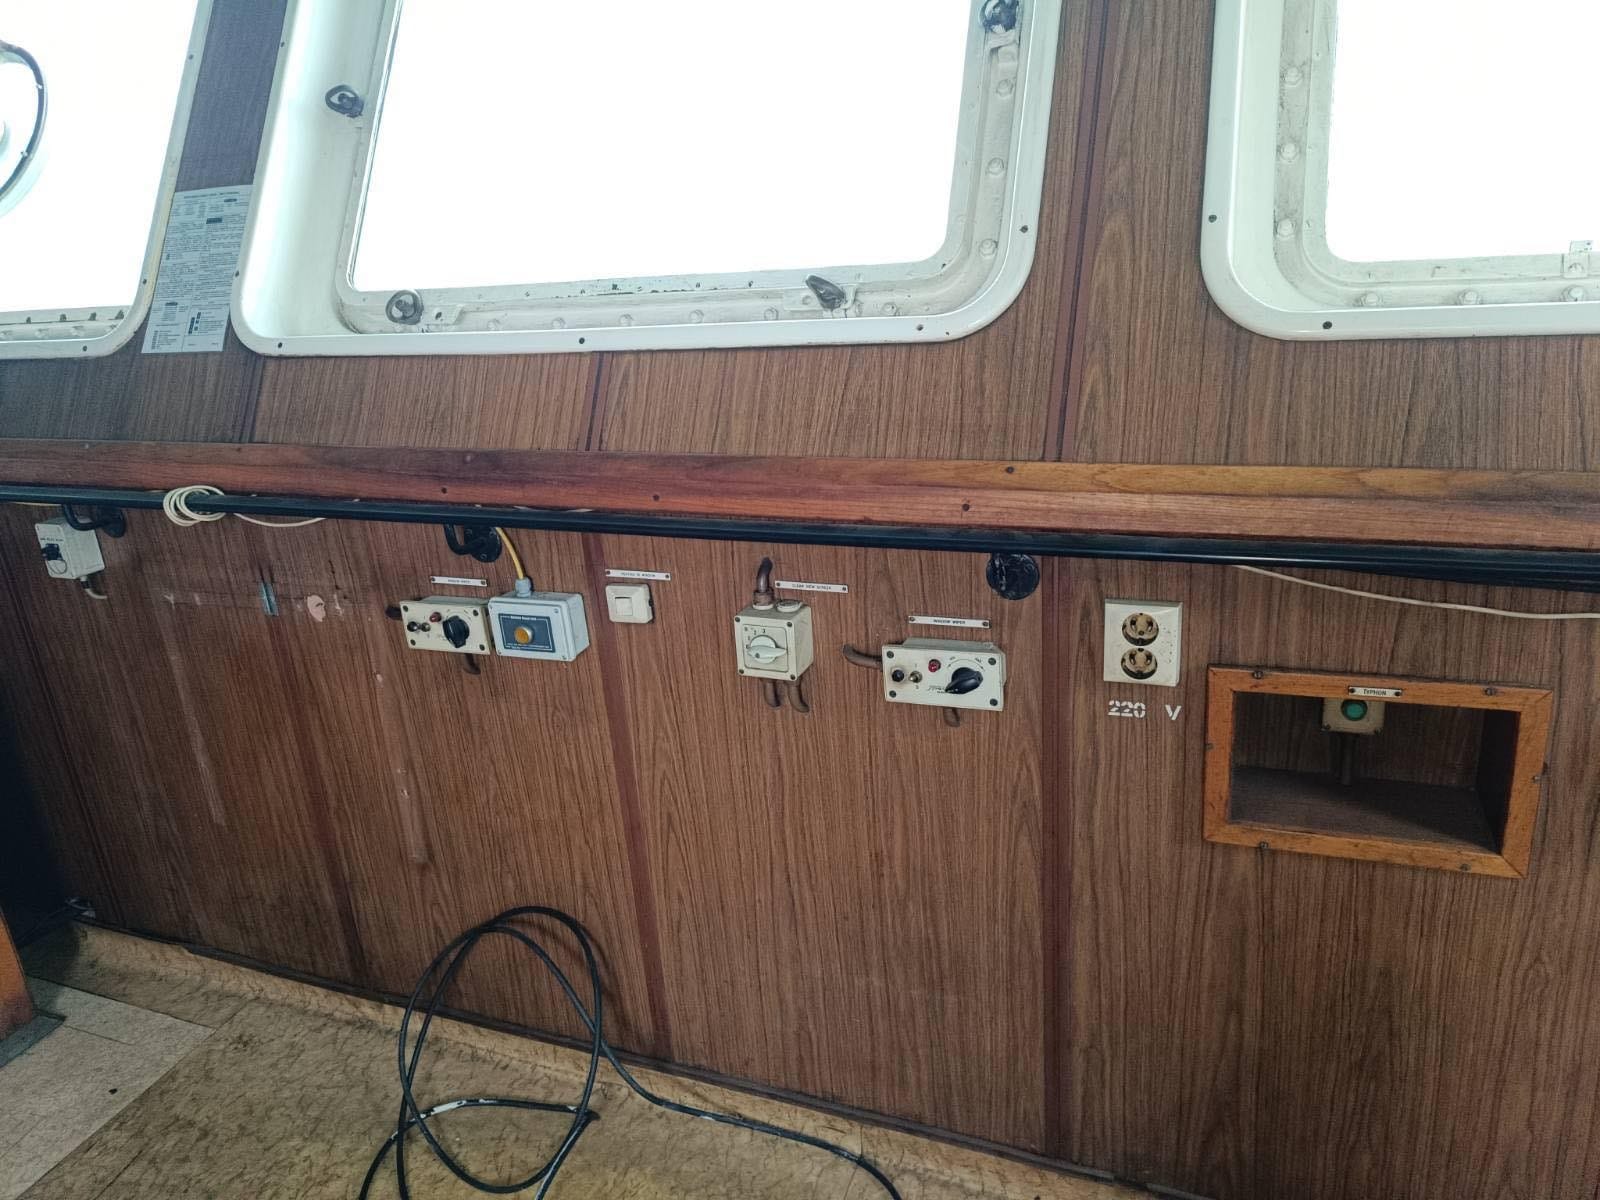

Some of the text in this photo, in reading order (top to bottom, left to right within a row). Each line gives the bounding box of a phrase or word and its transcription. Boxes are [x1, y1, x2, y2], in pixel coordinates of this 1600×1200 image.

[1363, 688, 1387, 696] TYPHON
[1108, 700, 1182, 721] 220 V
